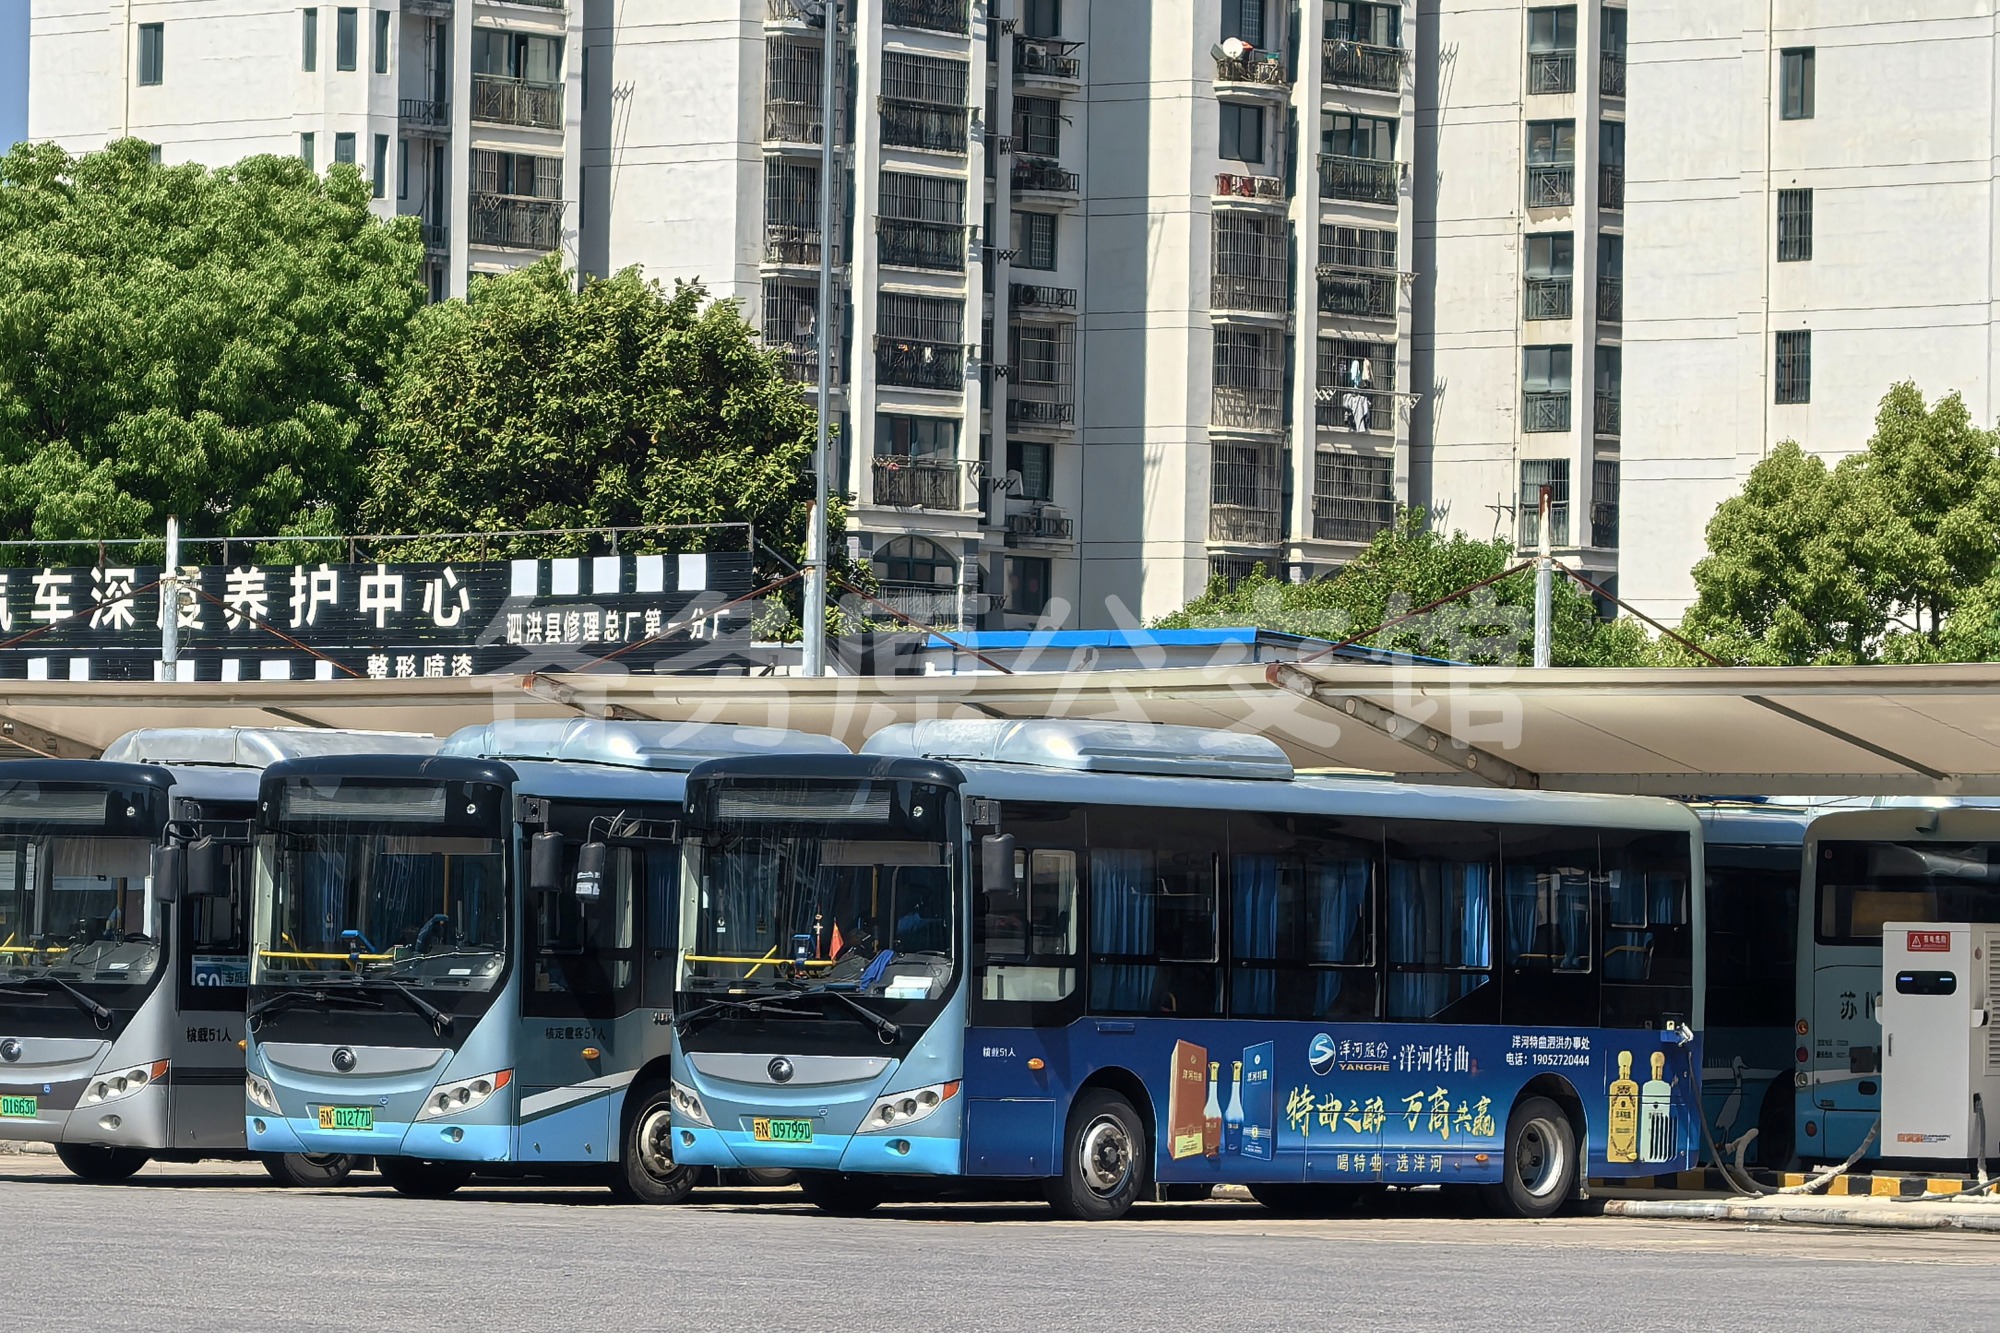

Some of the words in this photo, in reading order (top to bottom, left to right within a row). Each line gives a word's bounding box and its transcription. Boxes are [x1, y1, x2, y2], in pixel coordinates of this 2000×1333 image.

[506, 607, 730, 644] 泗洪县修理总厂第一分厂
[366, 653, 473, 679] 整形喷漆
[1339, 1040, 1389, 1060] 洋河股份
[1512, 1035, 1590, 1050] 洋河特曲泗洪办事处
[1340, 1063, 1390, 1071] YANGHE
[1532, 1053, 1590, 1066] 19052720444
